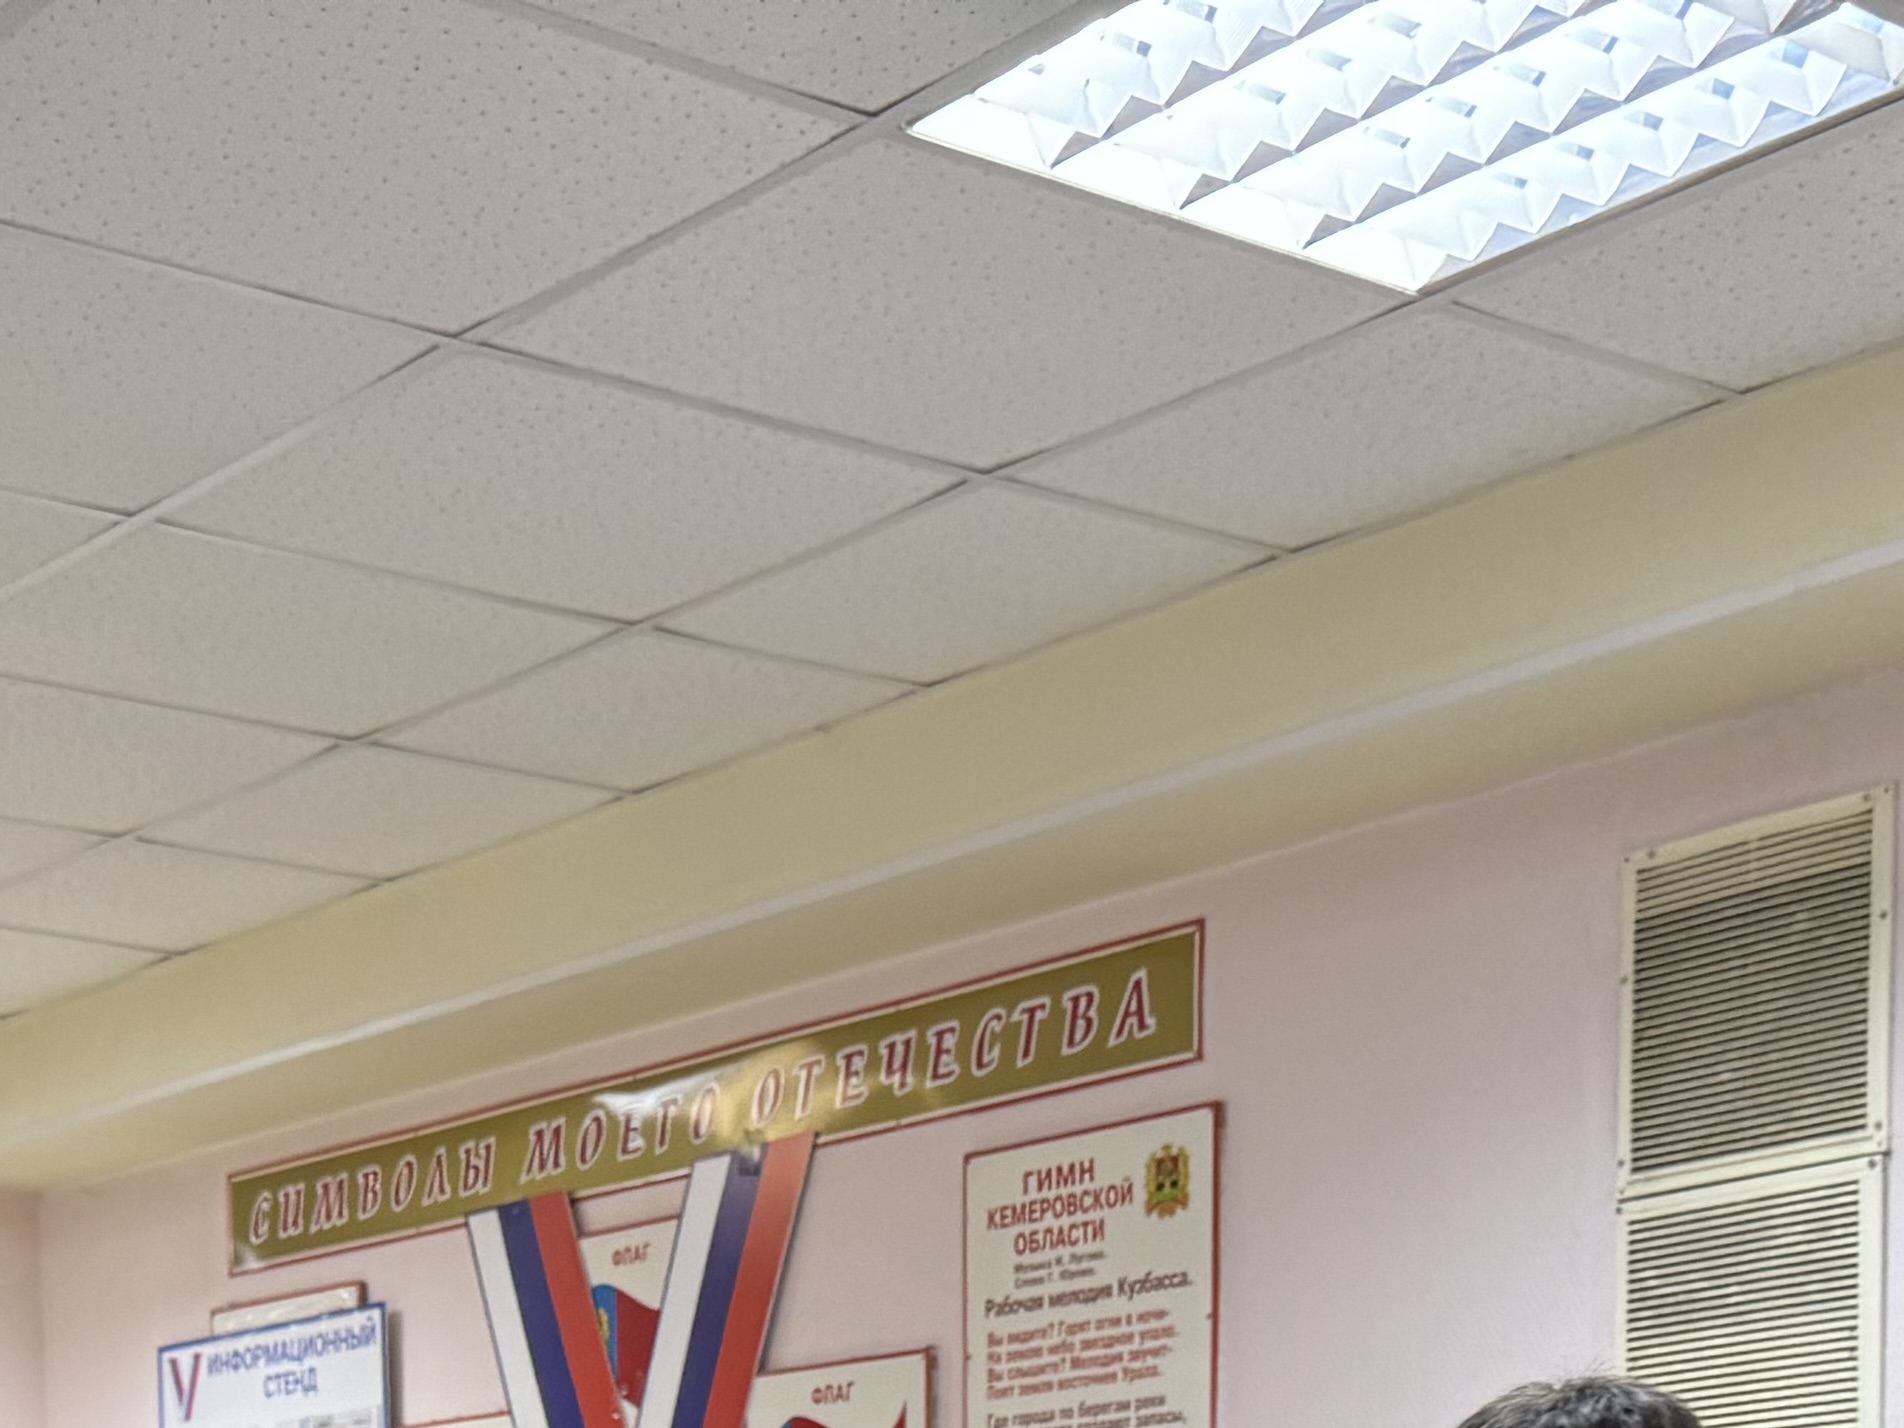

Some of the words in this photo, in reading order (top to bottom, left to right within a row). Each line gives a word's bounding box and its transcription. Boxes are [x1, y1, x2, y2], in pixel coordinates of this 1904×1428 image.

[249, 1136, 496, 1246] СИМВОЛЫ
[521, 1082, 720, 1183] МОЕГО
[751, 967, 1156, 1127] ОТЕЧЕСТВА
[1022, 1157, 1095, 1196] ГИМН
[986, 1175, 1134, 1230] КЕМЕРОВСКОЙ
[612, 1244, 652, 1266] ФЛАГ
[1013, 1218, 1105, 1256] ОБЛАСТИ
[206, 1315, 377, 1377] ИНФОРМАЦИОННЫЙ
[263, 1366, 318, 1399] СТЕНД
[811, 1381, 855, 1406] ФЛАГ
